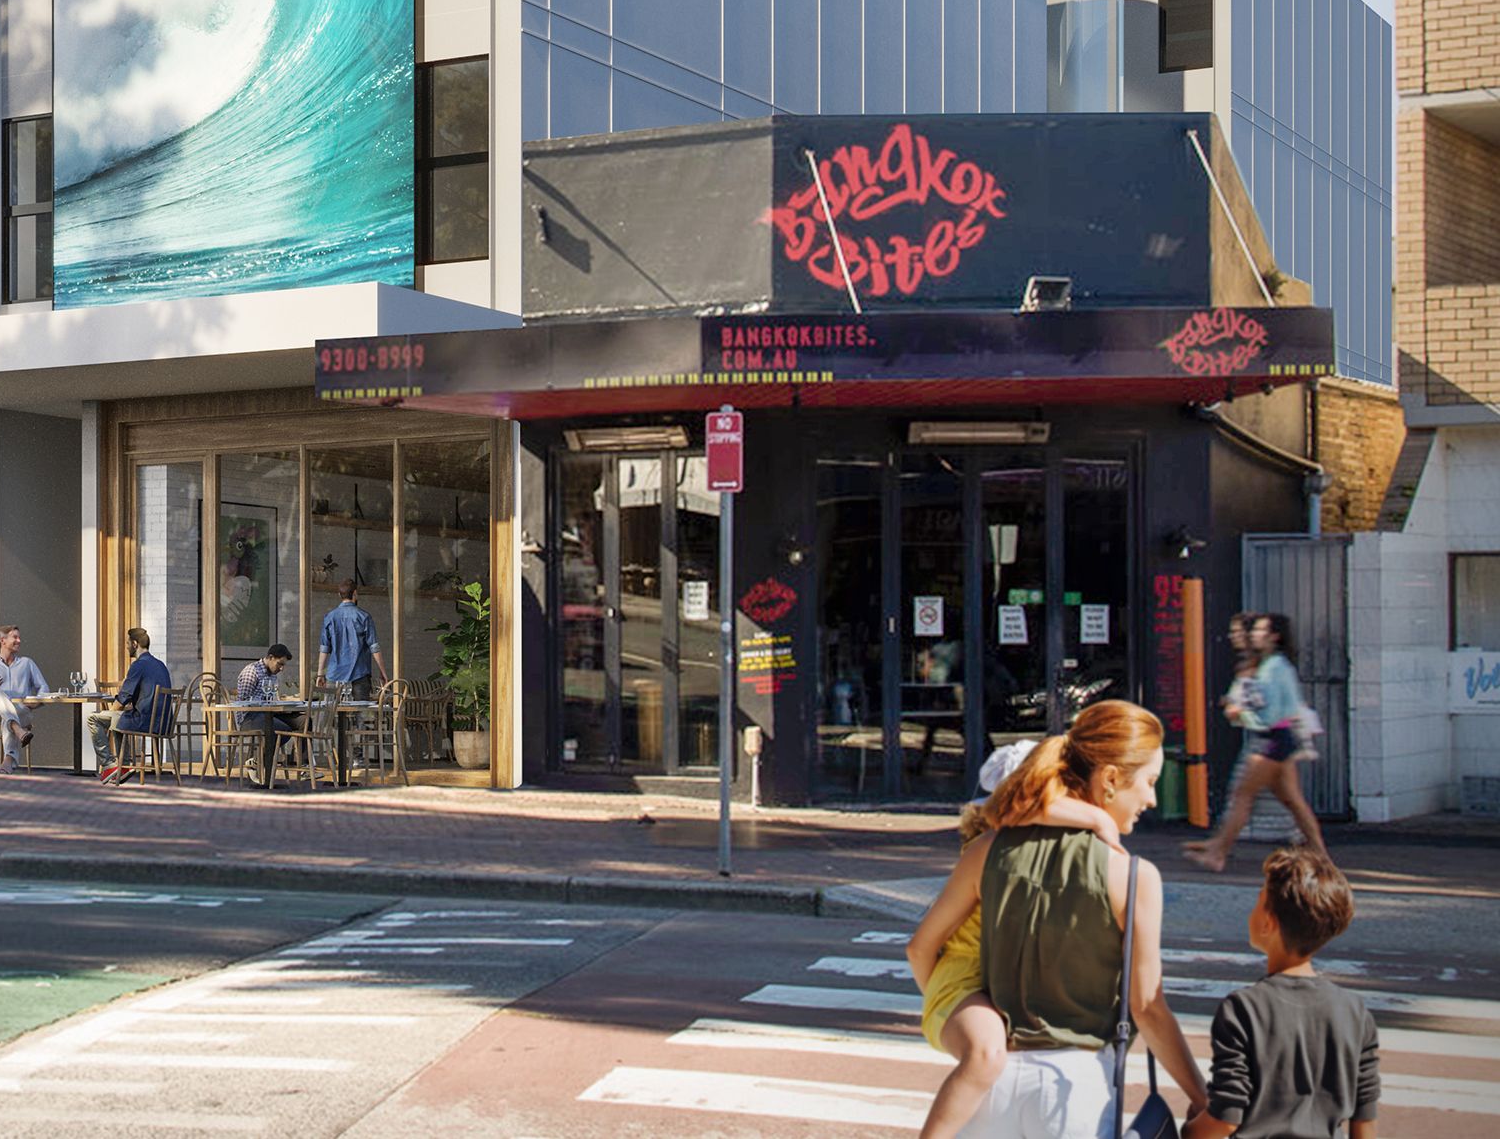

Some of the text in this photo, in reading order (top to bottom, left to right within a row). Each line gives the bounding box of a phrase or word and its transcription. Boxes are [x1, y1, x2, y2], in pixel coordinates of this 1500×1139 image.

[808, 210, 986, 296] Bites
[722, 349, 798, 370] COM.AU
[716, 416, 733, 431] NO
